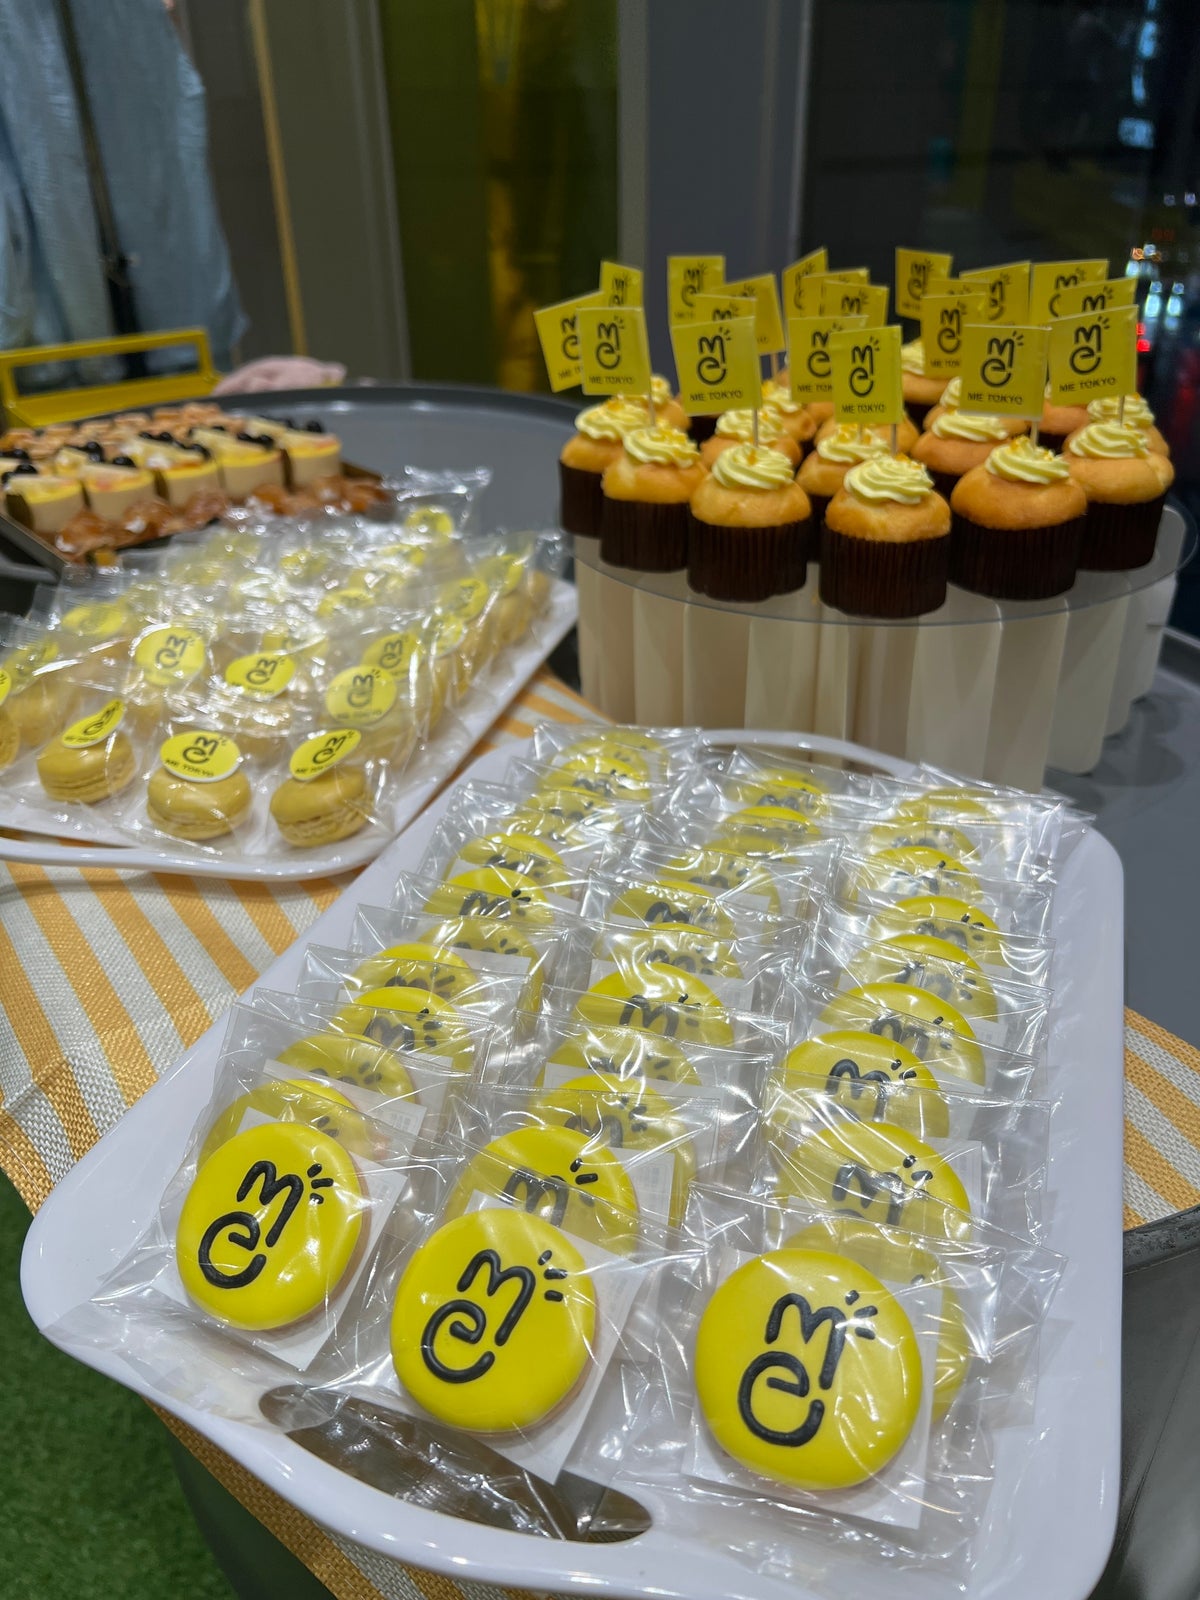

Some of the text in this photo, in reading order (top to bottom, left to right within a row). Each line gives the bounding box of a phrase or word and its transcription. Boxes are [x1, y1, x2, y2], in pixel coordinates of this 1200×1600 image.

[605, 376, 634, 385] TOKYO
[1059, 377, 1117, 392] ME TOKYO
[690, 390, 742, 401] ME TOKYO
[968, 392, 1023, 405] ME TOKYO
[842, 404, 886, 414] ME TOKYO
